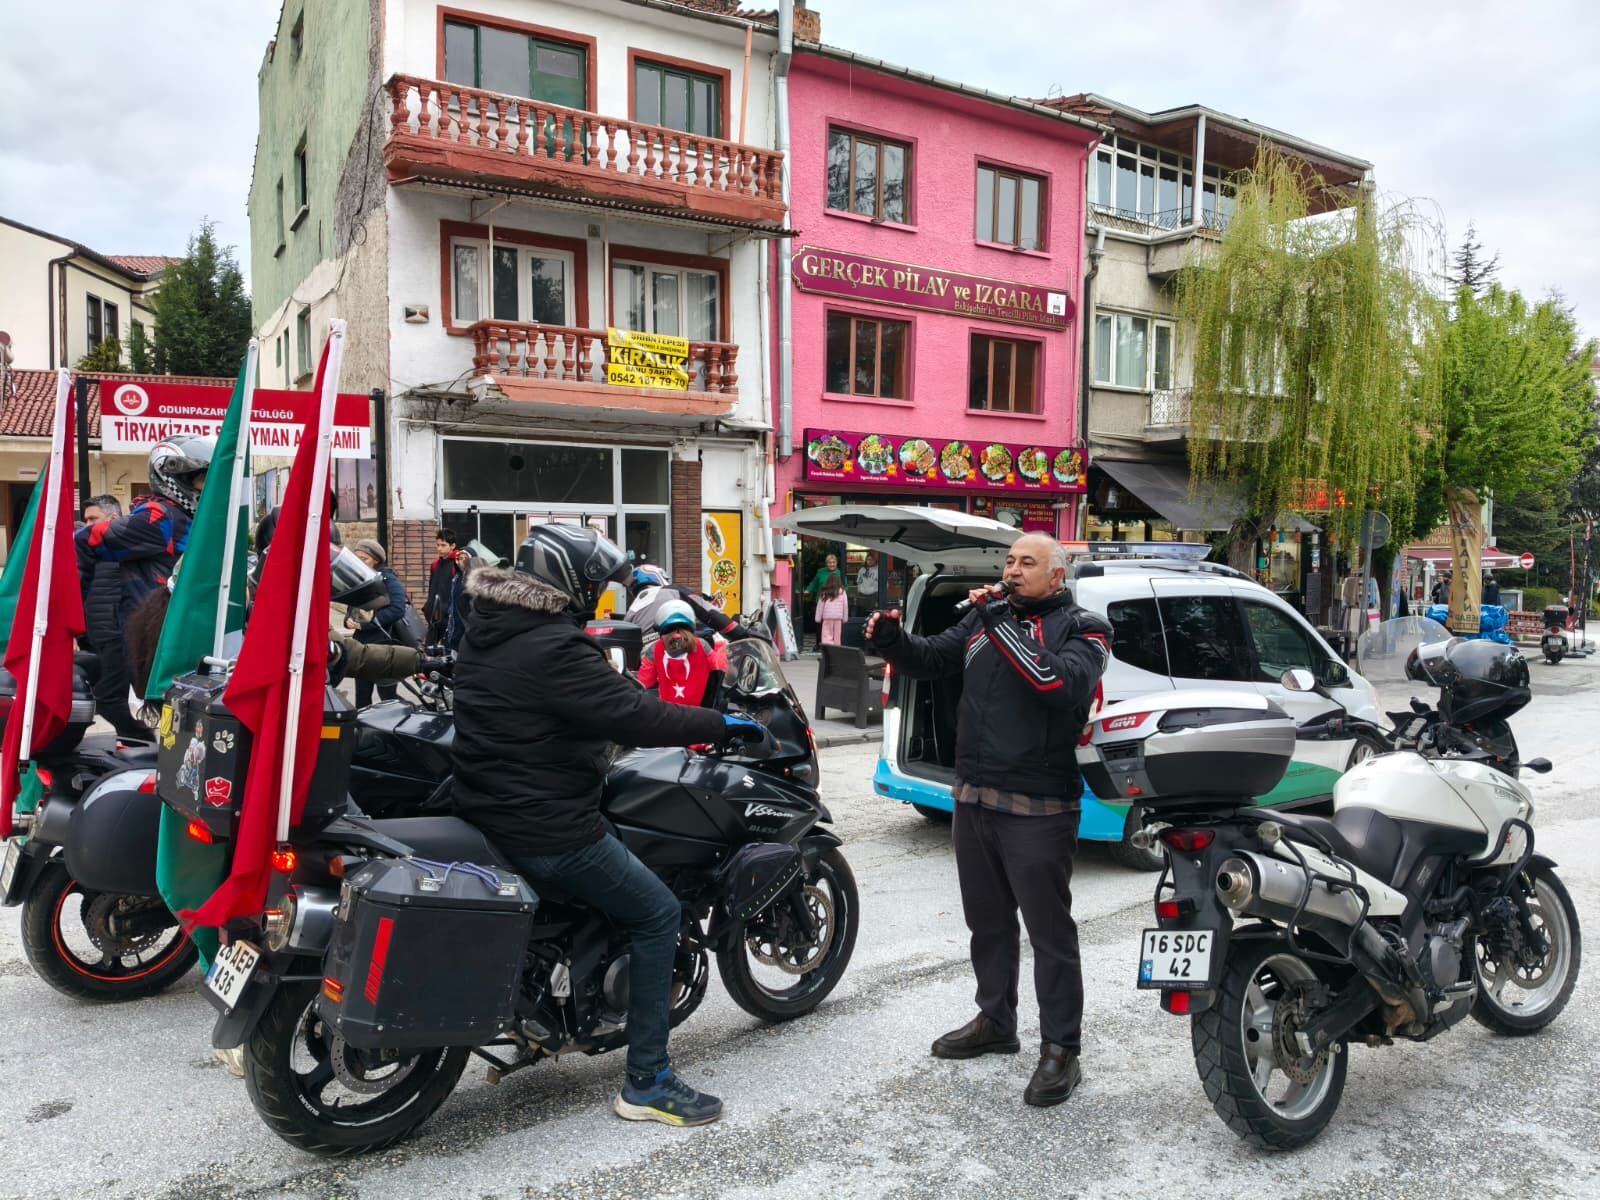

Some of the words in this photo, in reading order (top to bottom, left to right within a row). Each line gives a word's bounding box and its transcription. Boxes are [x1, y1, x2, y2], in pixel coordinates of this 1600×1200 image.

[802, 254, 888, 289] GERÇEK
[892, 267, 951, 297] PİLAV
[953, 285, 970, 301] ve
[975, 284, 1044, 313] IZGARA
[610, 372, 636, 384] 0542
[659, 376, 671, 386] 79
[249, 407, 294, 420] TÜLÜĞÜ
[333, 427, 361, 450] AMİİ
[1150, 934, 1169, 954] 16
[1172, 934, 1207, 954] SDC
[229, 945, 255, 975] AEP
[1169, 957, 1192, 977] 42
[213, 966, 235, 996] 436
